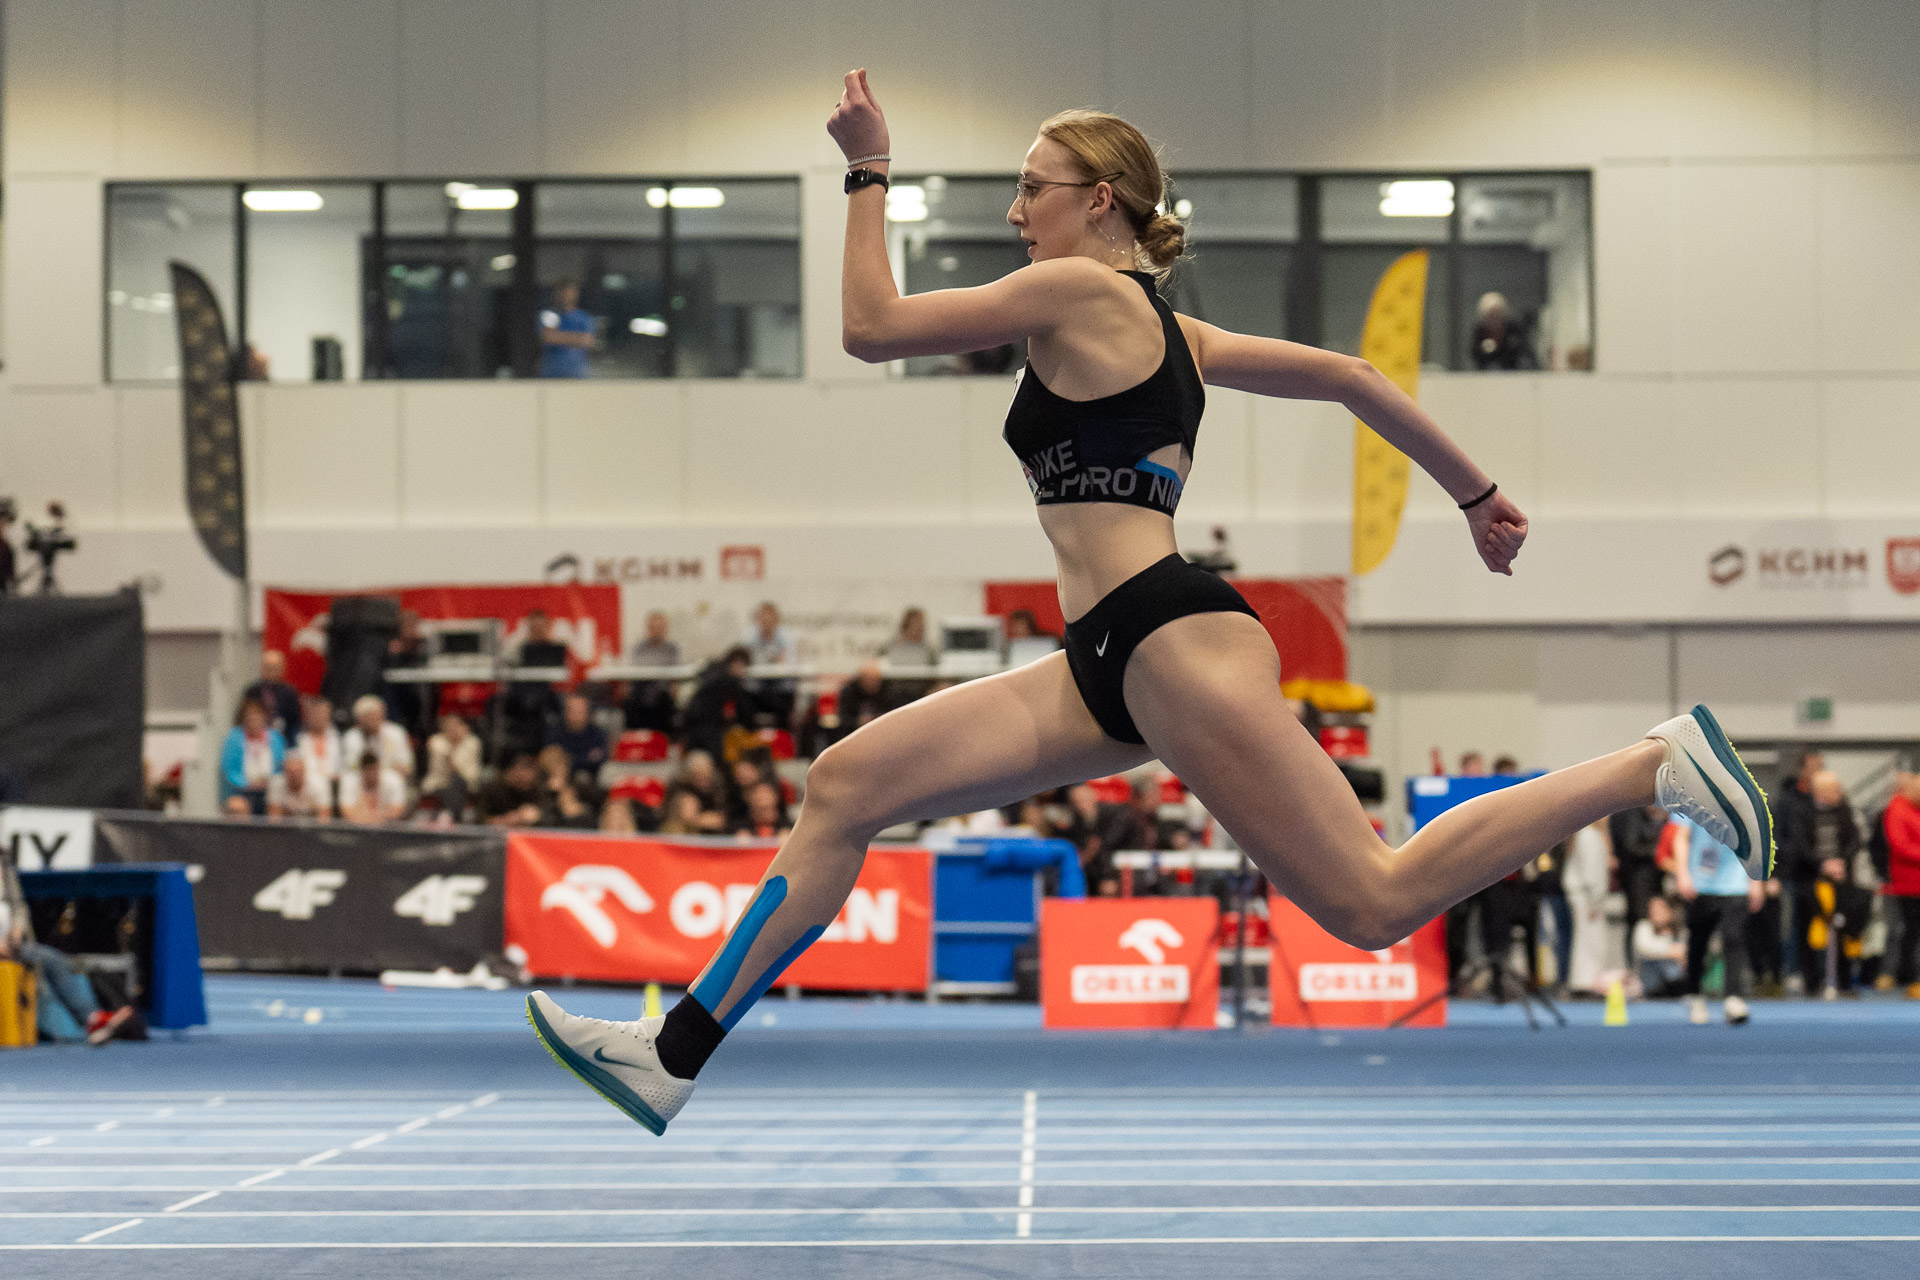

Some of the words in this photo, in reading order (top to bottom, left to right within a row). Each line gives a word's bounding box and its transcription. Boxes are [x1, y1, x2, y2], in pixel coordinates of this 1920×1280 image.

[1028, 439, 1077, 482] NIKE
[1758, 550, 1869, 576] KGHM
[253, 868, 348, 920] 4F
[393, 874, 488, 926] 4F
[1082, 974, 1178, 994] ORLEN
[1310, 973, 1406, 992] ORLEN
